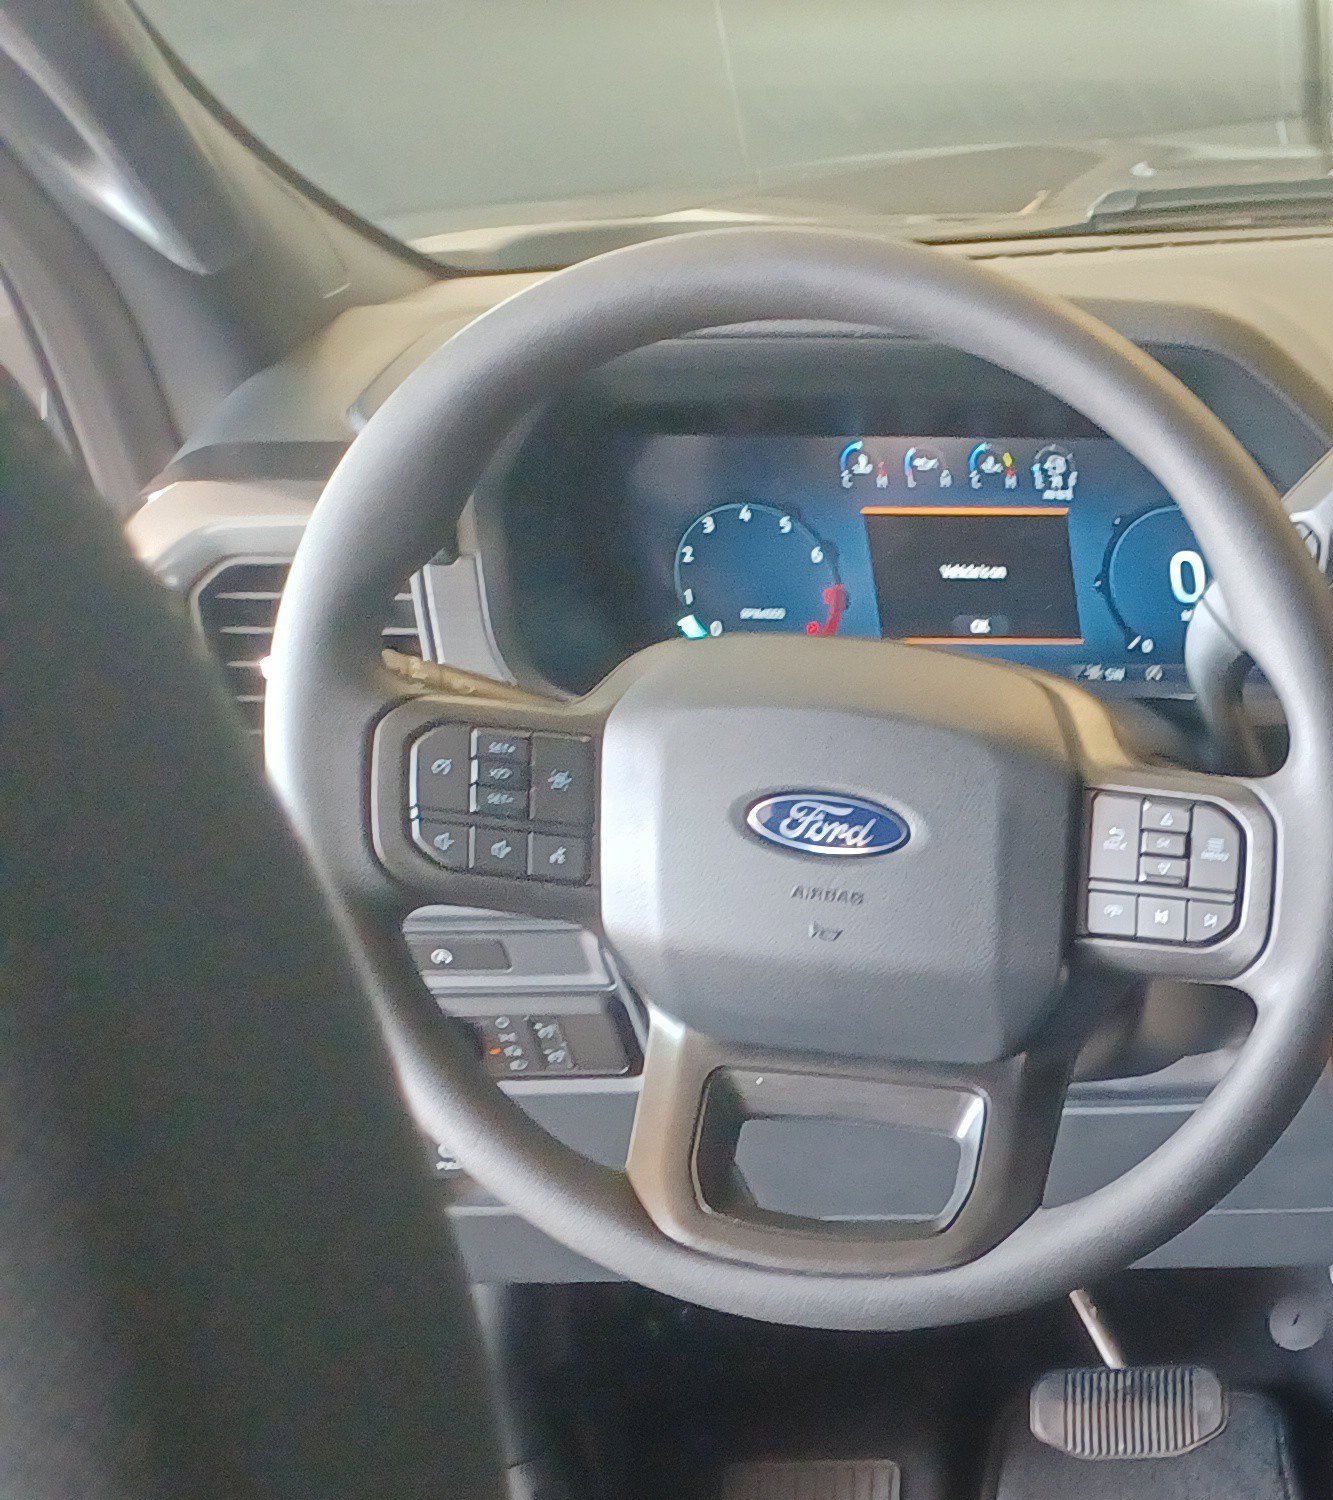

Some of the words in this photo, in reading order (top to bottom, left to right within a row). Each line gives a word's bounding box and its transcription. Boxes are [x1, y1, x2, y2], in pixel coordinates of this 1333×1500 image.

[701, 516, 716, 534] 3
[779, 515, 792, 534] 5
[681, 545, 695, 563] 2
[811, 546, 824, 564] 6
[1169, 549, 1206, 604] 0
[683, 588, 694, 605] 1
[779, 800, 877, 847] Ford
